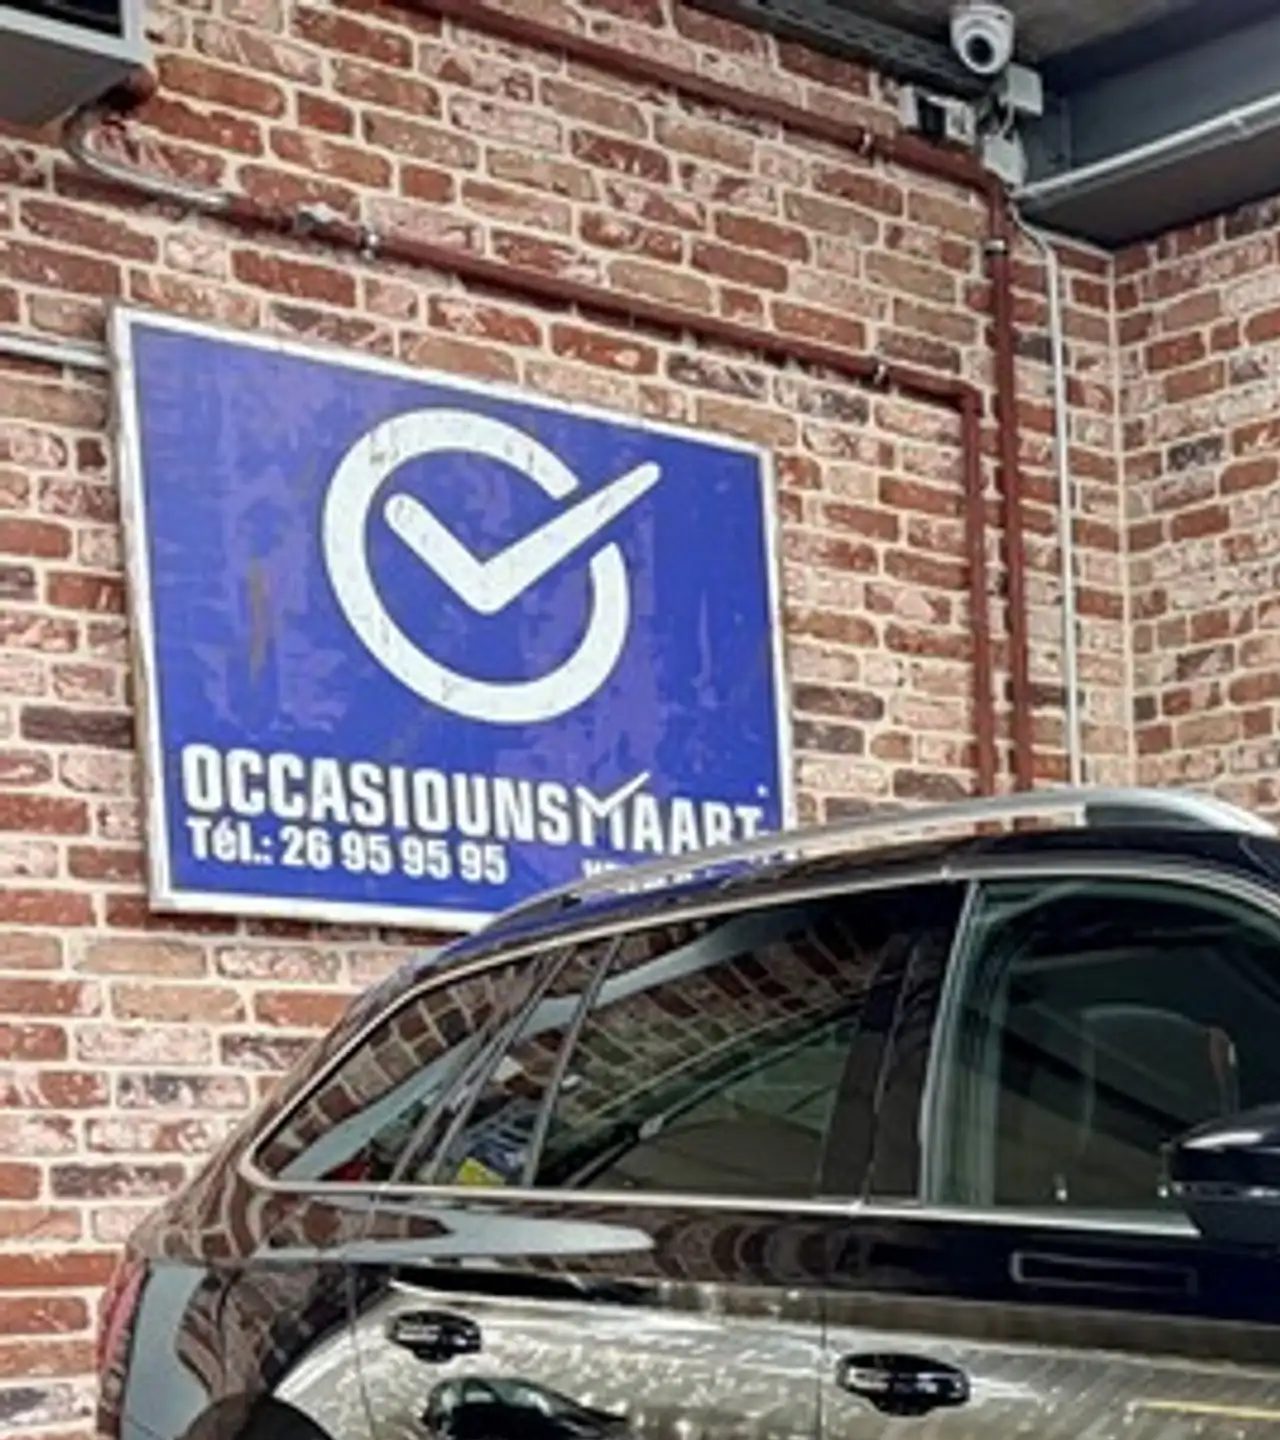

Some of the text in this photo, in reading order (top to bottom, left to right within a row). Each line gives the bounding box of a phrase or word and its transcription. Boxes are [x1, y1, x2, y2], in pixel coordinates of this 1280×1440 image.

[186, 816, 509, 885] Tél.: 26 95 95 95
